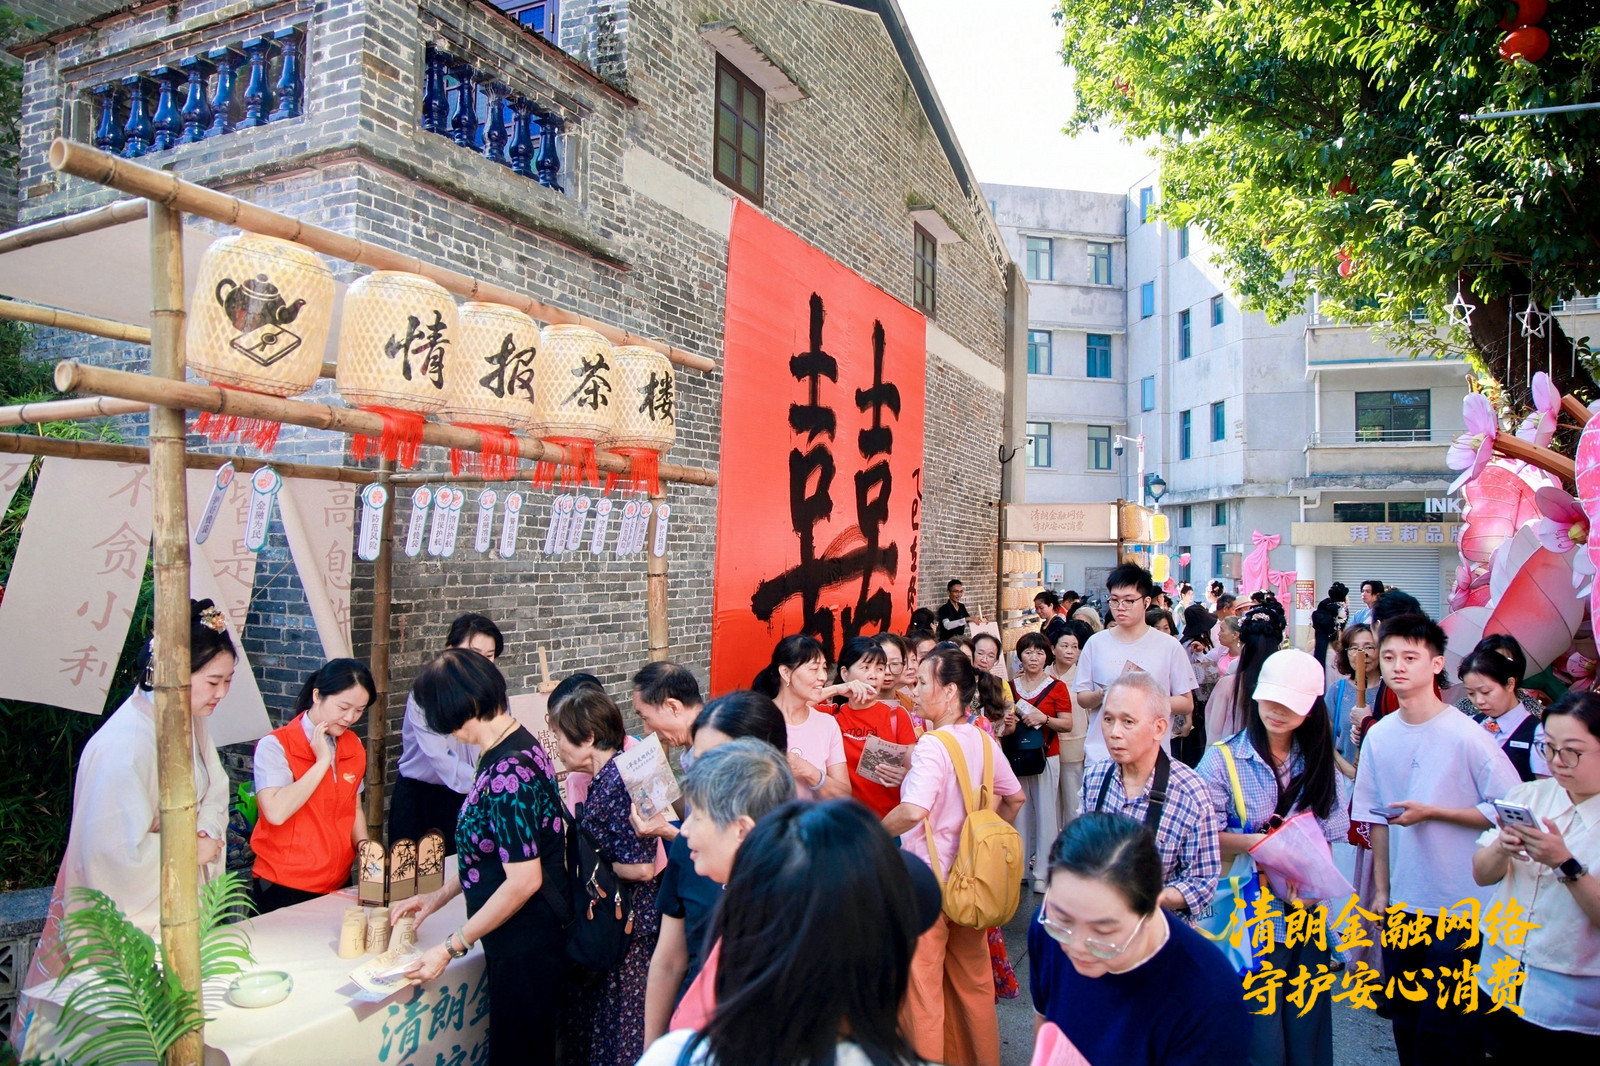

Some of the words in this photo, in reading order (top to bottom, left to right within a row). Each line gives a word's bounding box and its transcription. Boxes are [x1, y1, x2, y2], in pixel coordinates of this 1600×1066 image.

[250, 500, 266, 540] 金融为民
[1030, 508, 1086, 520] 清朗金融网络
[1032, 520, 1085, 532] 守护安心消费
[368, 513, 380, 550] 防范风险
